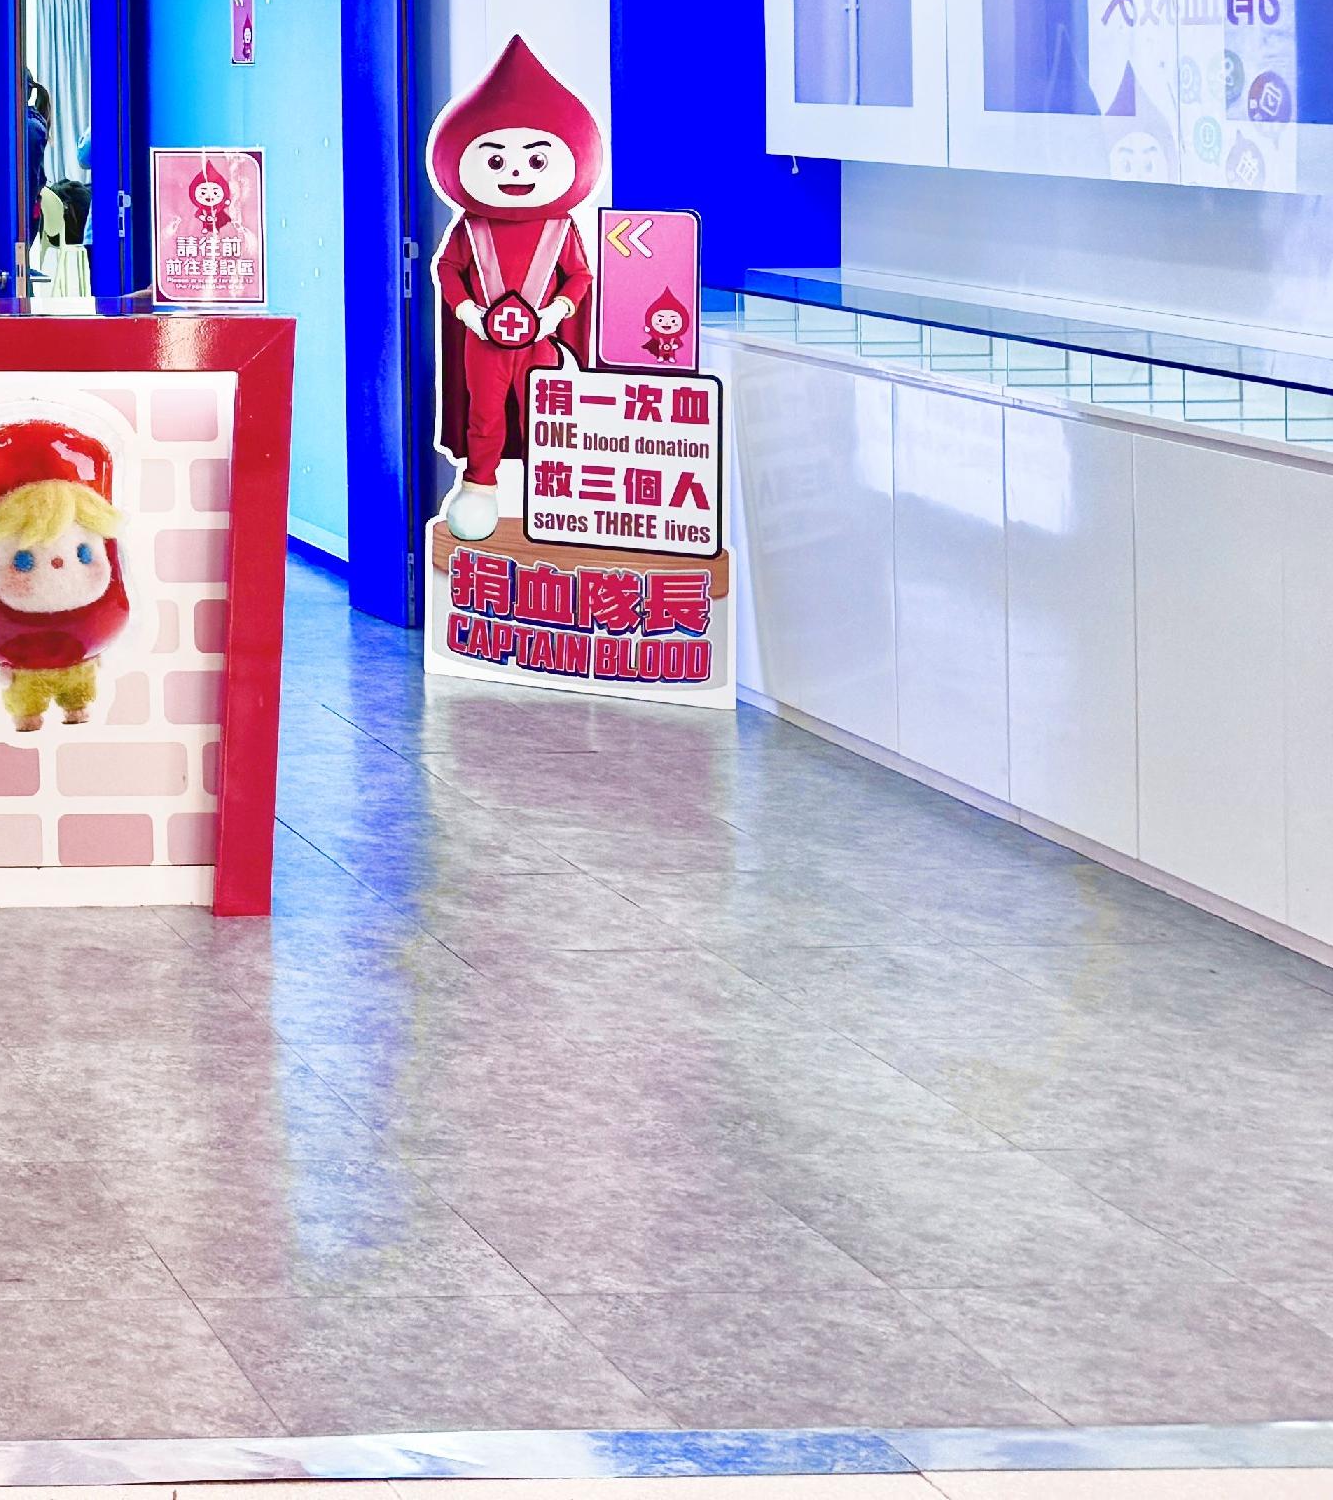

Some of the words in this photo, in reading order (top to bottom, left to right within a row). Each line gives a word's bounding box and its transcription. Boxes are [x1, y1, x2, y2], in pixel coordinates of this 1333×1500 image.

[535, 378, 710, 425] 捐一次血
[534, 420, 578, 450] ONE
[583, 432, 630, 454] blood
[635, 436, 710, 460] donation
[534, 460, 711, 511] 救三個人
[533, 511, 589, 533] saves
[593, 510, 658, 540] THREE
[664, 519, 711, 544] lives
[449, 546, 711, 637] 捐血隊長
[447, 611, 591, 678] CAPTAIN
[594, 636, 712, 683] BLOOD
